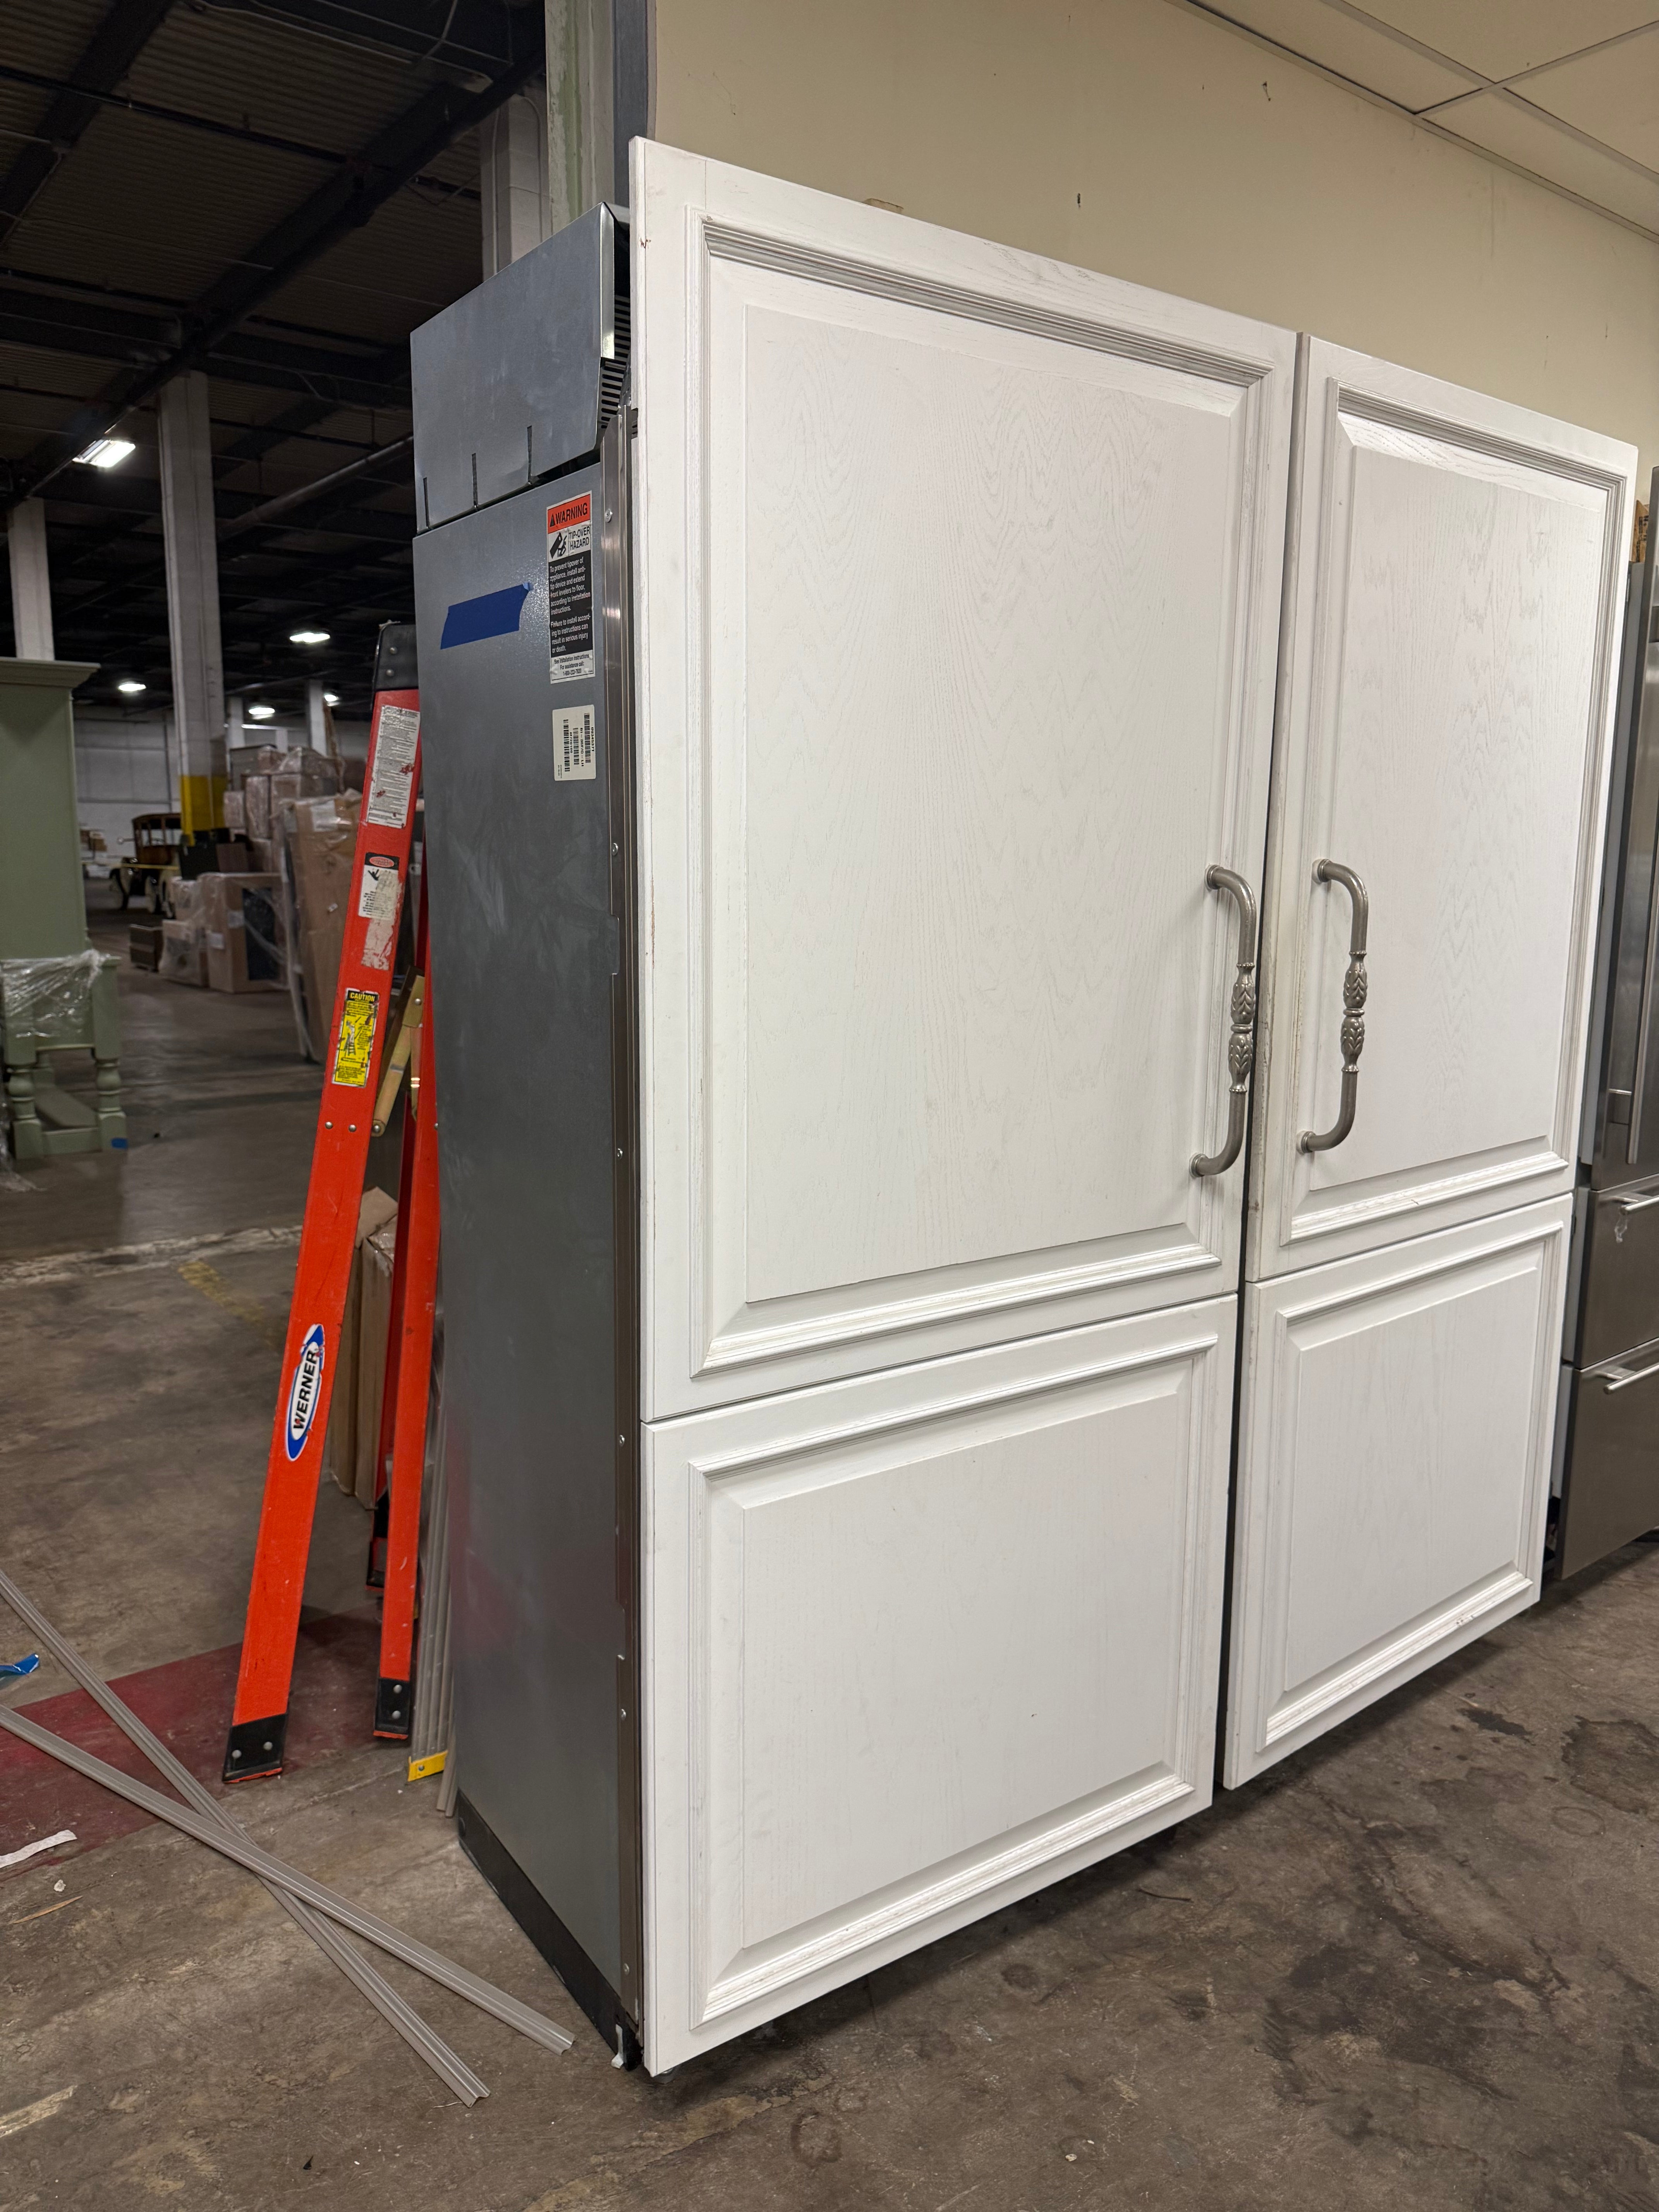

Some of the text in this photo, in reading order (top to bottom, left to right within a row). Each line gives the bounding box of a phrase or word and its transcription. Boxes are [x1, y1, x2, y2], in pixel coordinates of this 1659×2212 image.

[555, 503, 587, 524] WARNING
[569, 526, 590, 540] TIP-OVER
[570, 537, 589, 550] HAZARD
[555, 562, 567, 573] prevent
[567, 560, 579, 568] tipover
[567, 568, 577, 576] install
[573, 574, 585, 583] extend
[550, 598, 567, 607] according
[571, 592, 591, 601] installation
[567, 616, 577, 624] install
[577, 613, 591, 622] accord-
[562, 625, 581, 634] instructions
[579, 632, 588, 640] injury
[350, 992, 375, 1002] CAUTION
[293, 1349, 319, 1429] WERNER
